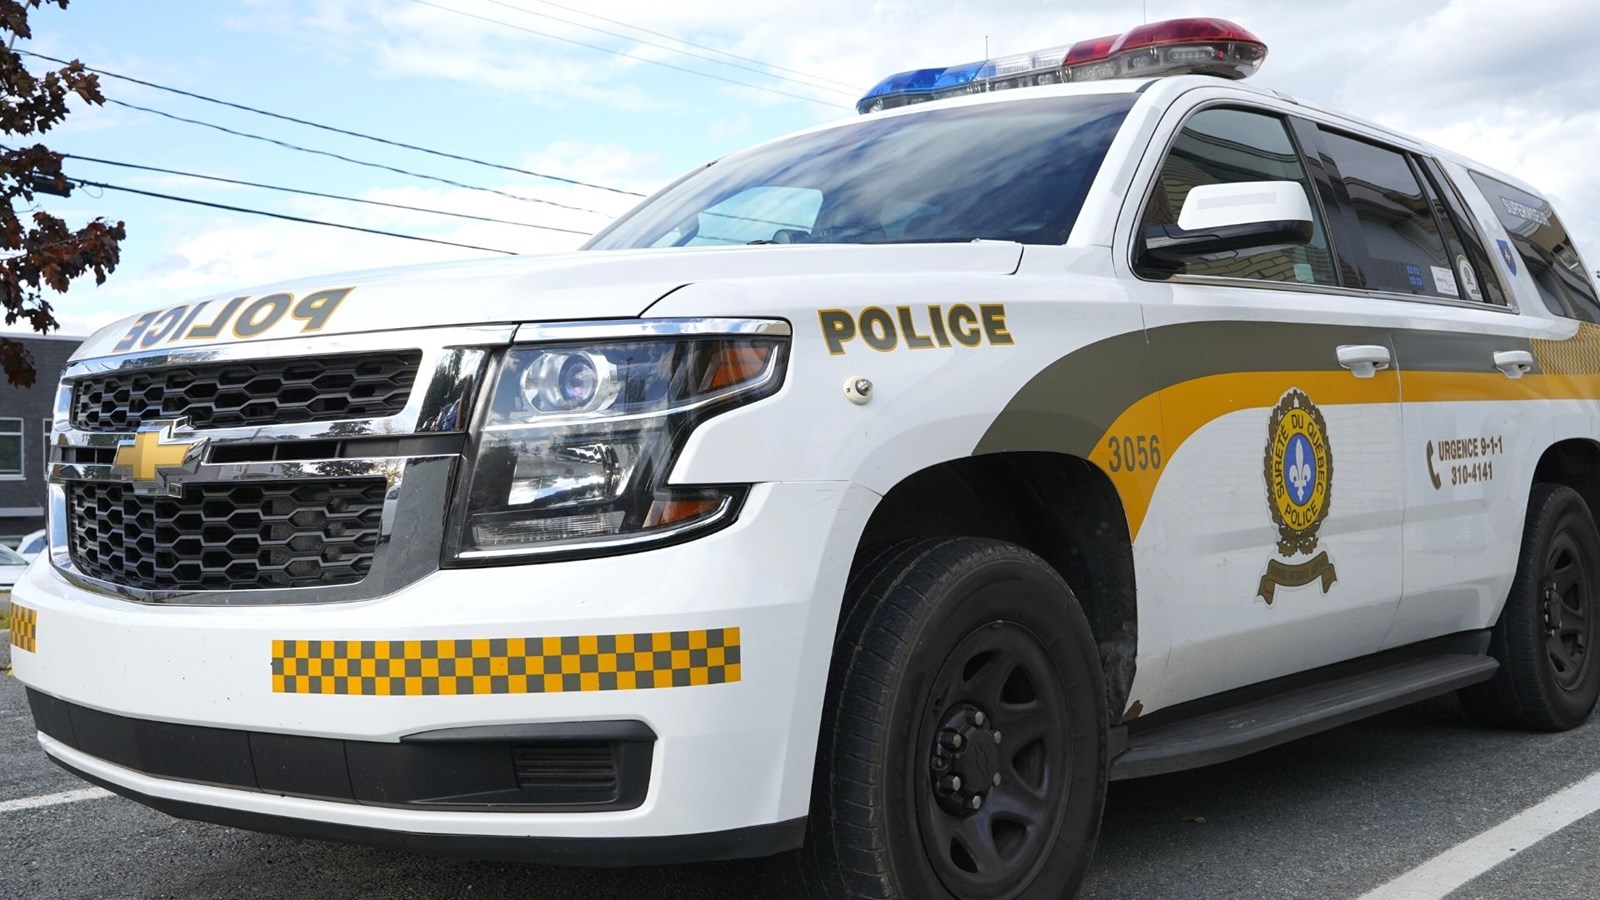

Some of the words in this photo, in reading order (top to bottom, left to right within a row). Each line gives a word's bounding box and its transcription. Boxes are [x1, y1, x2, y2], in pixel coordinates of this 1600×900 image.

[817, 303, 1015, 355] POLICE
[1108, 435, 1161, 472] 3056
[1291, 414, 1304, 429] DU
[1307, 422, 1325, 495] QUÉBEC
[1438, 438, 1478, 461] URGENCE
[1481, 435, 1502, 456] 9-1-1
[1452, 461, 1492, 485] 310-4141
[1284, 500, 1318, 526] POLICE
